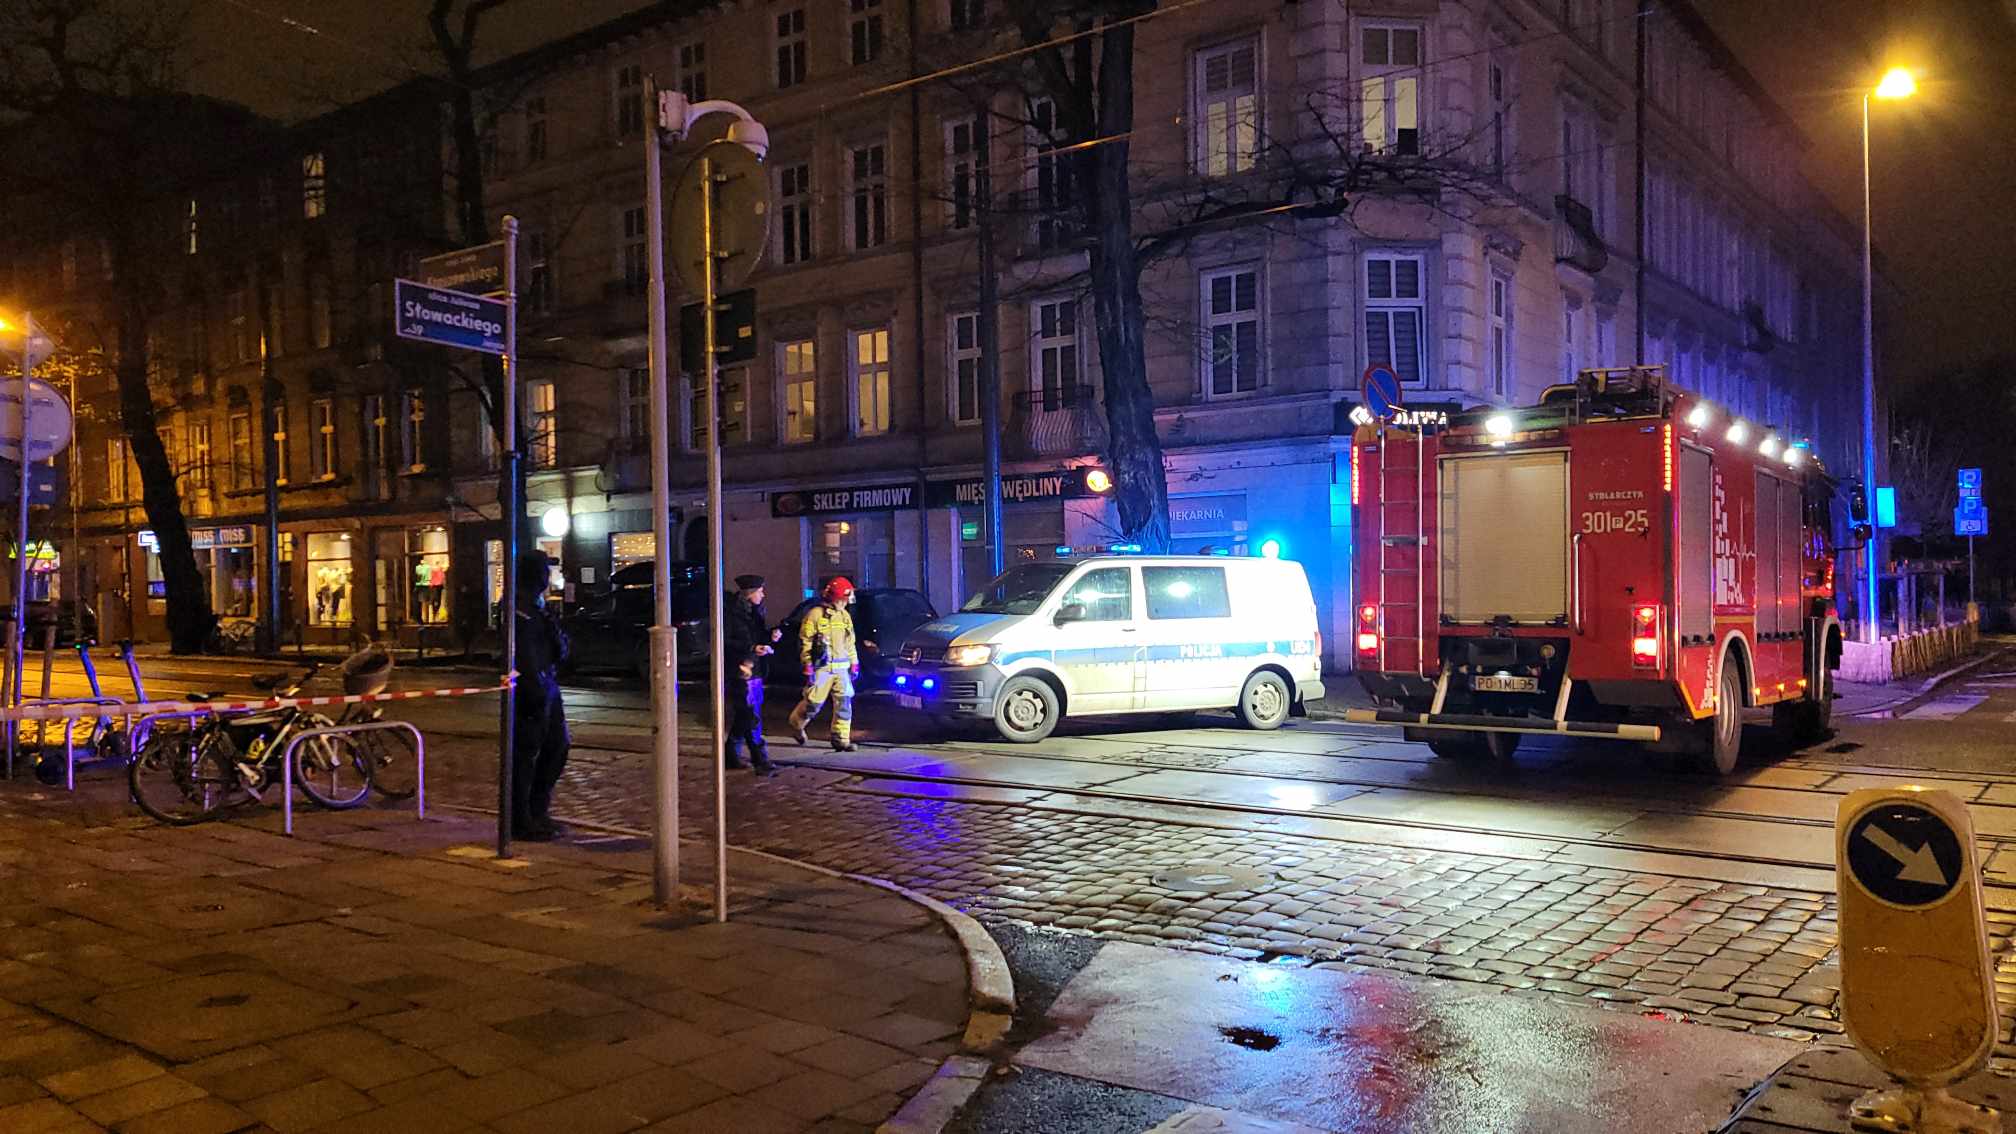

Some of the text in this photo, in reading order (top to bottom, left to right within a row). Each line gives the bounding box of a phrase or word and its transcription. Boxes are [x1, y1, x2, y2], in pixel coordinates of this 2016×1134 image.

[405, 301, 501, 337] Słowackiego
[814, 488, 912, 511] SKLEP FIRMOWY
[956, 477, 1063, 504] MIĘS WĘDLINY
[1963, 499, 1977, 513] P
